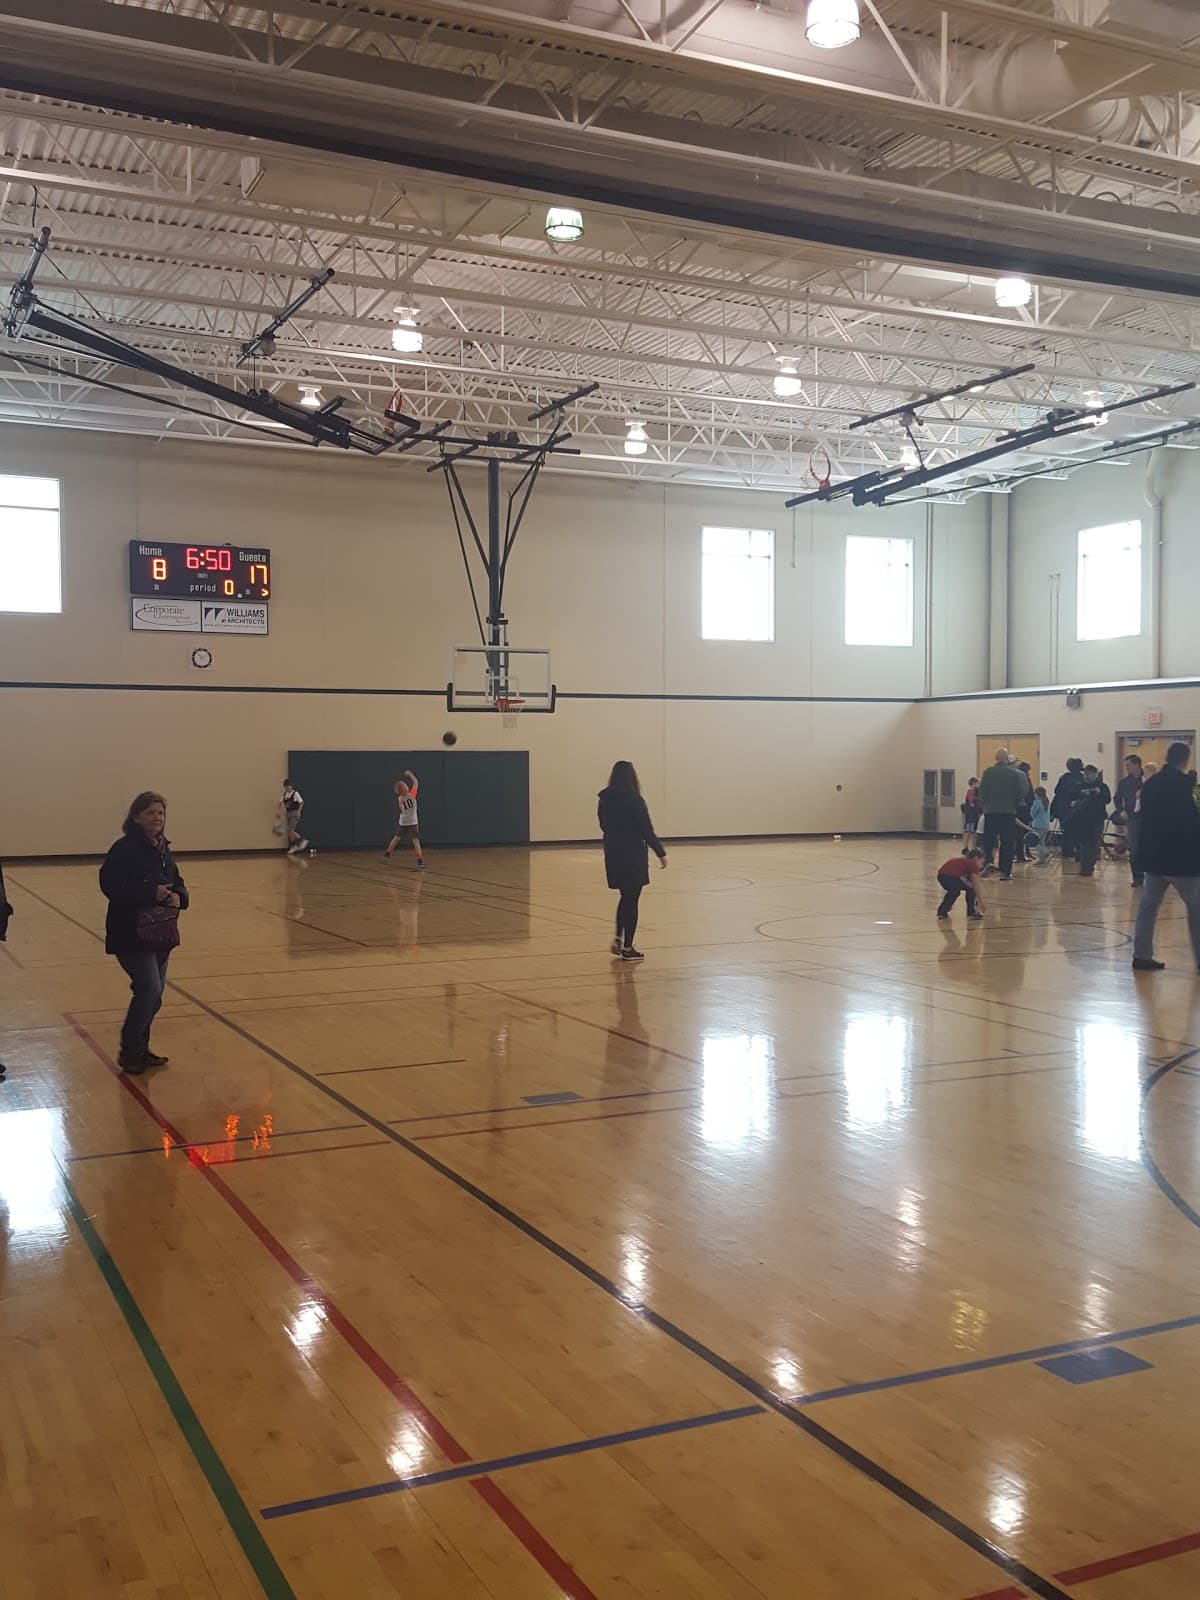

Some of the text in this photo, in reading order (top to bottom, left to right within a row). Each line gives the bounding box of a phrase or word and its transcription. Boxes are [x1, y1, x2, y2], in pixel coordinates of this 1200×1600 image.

[139, 545, 163, 556] Home
[186, 548, 232, 571] 6:50
[239, 551, 267, 563] Guests
[152, 559, 167, 581] 8
[250, 565, 268, 585] 17
[189, 583, 217, 593] period
[224, 579, 235, 596] 0
[226, 607, 265, 618] WILLIAMS
[402, 798, 414, 810] 10
